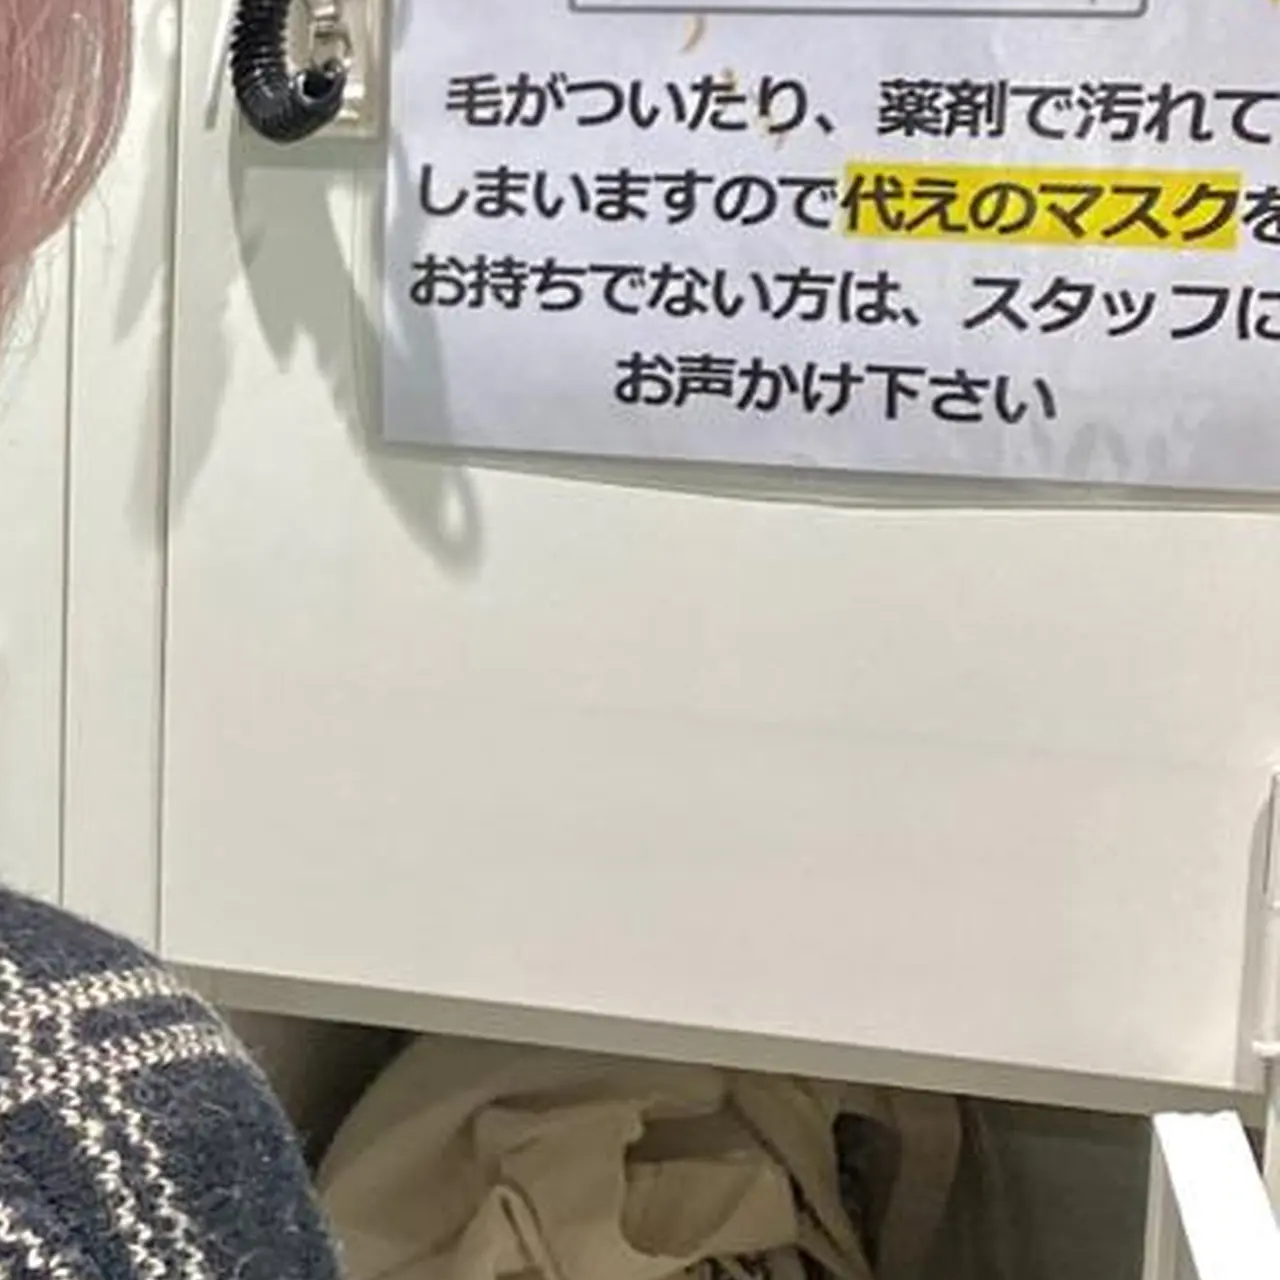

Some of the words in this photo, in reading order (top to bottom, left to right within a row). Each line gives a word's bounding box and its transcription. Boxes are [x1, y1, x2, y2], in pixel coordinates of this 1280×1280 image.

[614, 351, 1057, 423] お声かけ下さい
